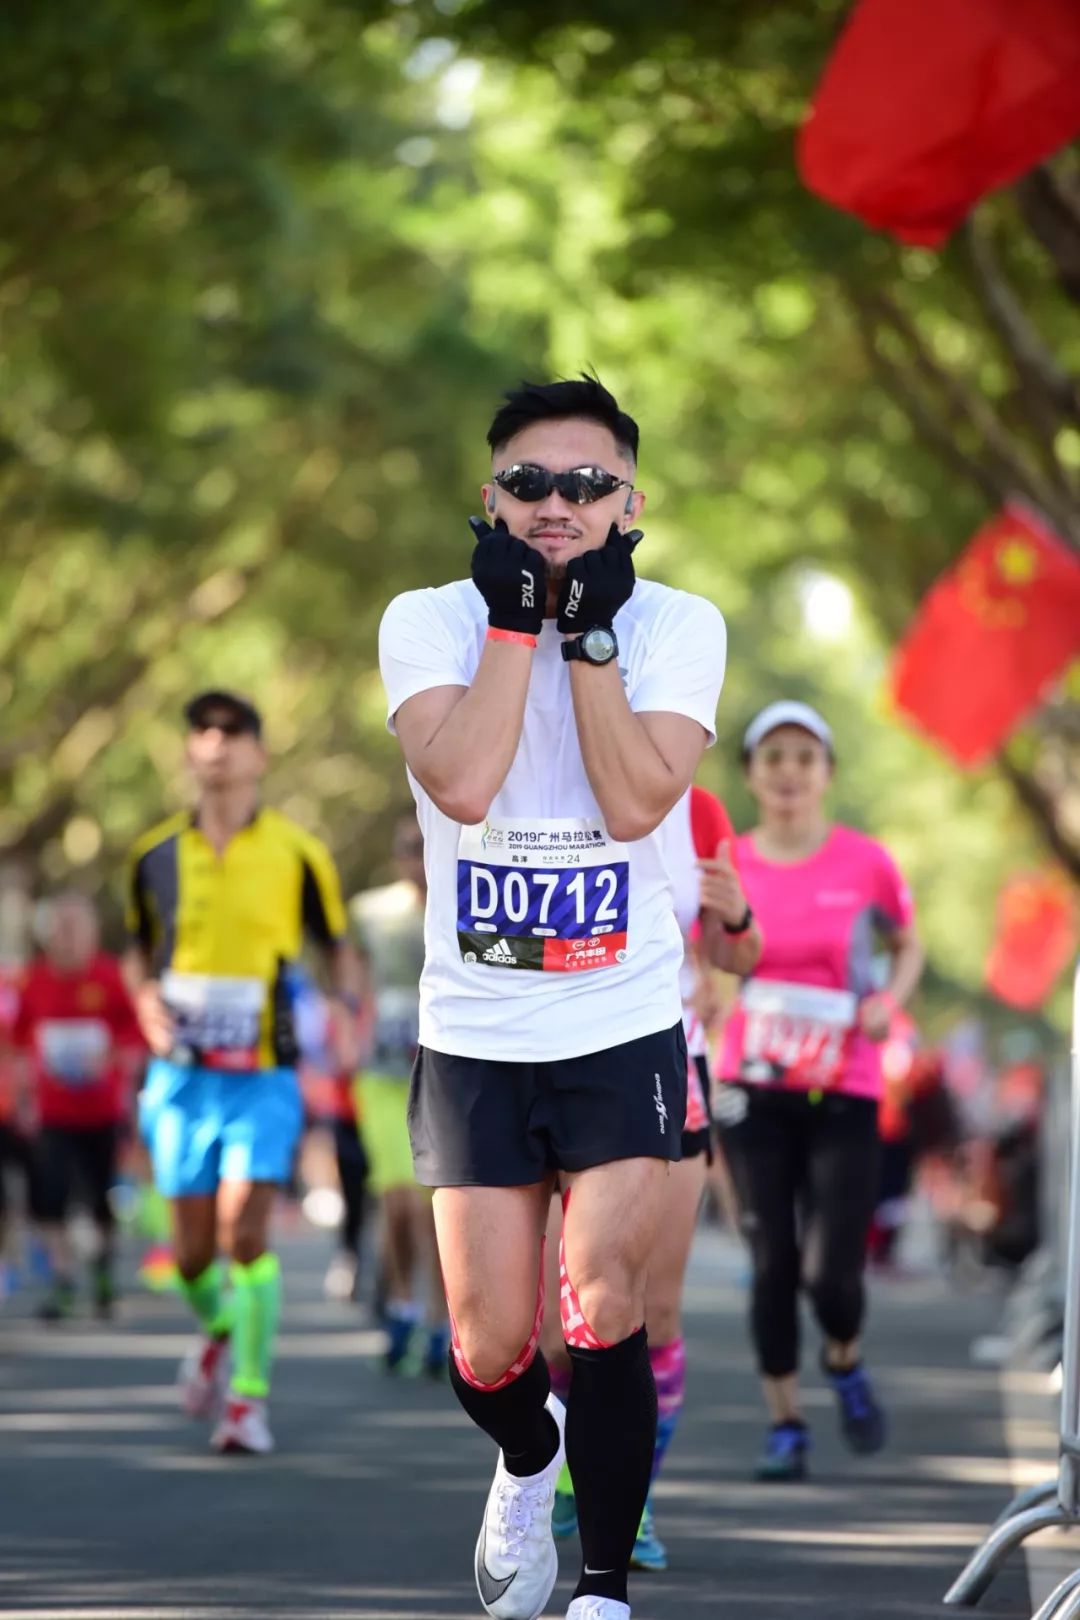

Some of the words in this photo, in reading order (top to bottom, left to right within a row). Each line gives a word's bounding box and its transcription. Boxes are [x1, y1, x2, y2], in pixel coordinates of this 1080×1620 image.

[521, 569, 534, 608] 2XU
[565, 579, 584, 618] 2XU
[524, 843, 568, 851] GUANGZHOU
[569, 842, 606, 850] MARATHON
[567, 854, 580, 863] 24
[470, 866, 618, 924] D0712
[482, 953, 517, 965] adidas
